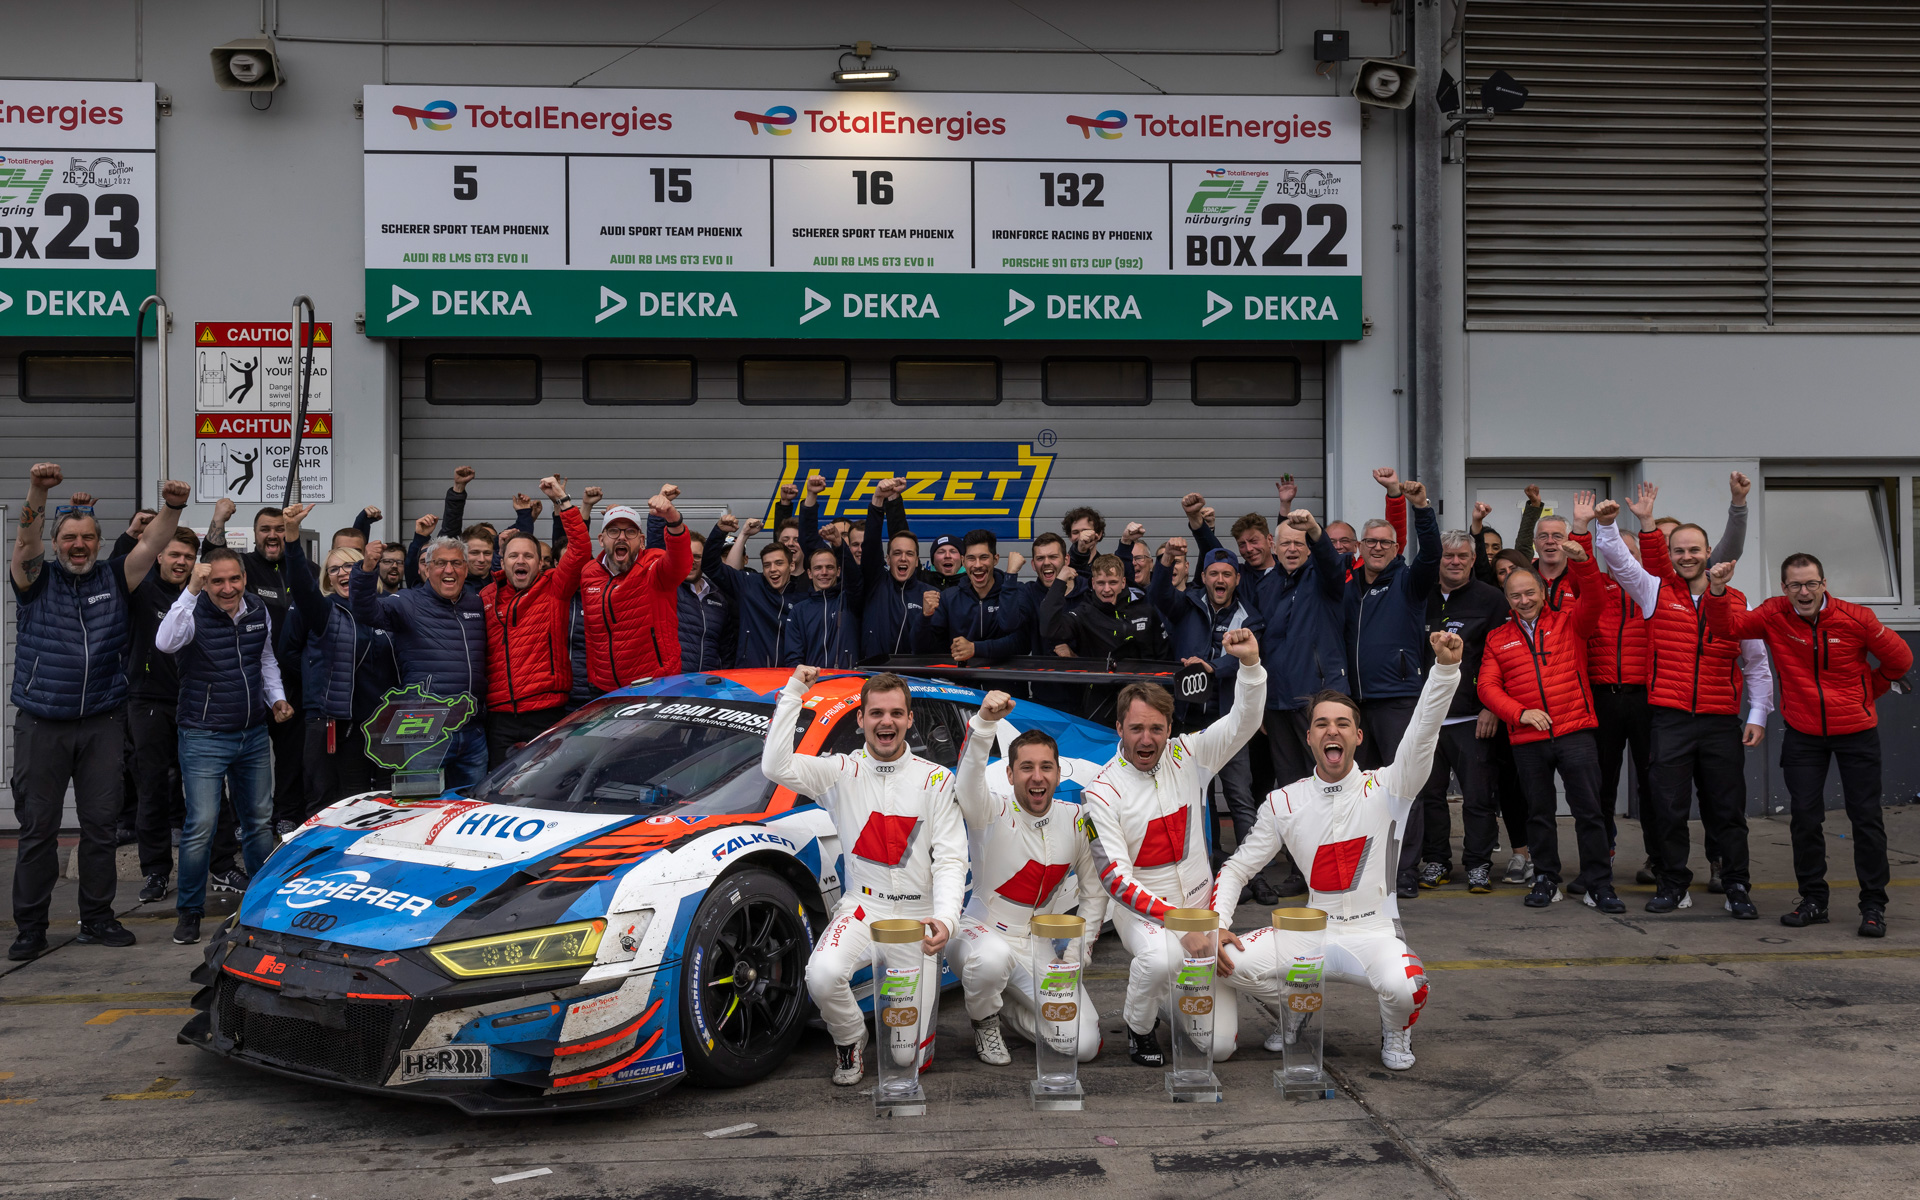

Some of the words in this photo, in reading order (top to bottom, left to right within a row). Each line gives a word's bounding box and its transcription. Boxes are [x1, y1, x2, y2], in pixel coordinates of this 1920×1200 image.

[0, 99, 123, 131] nergies
[464, 104, 673, 137] TotalEnergies
[804, 110, 1006, 141] TotalEnergies
[1134, 113, 1332, 144] TotalEnergies
[8, 158, 54, 166] TotalEnergies
[63, 171, 95, 184] 26-29
[108, 167, 134, 175] EDITION
[1227, 170, 1269, 178] TotalEnergies
[454, 165, 478, 200] 5
[649, 167, 693, 203] 15
[852, 170, 894, 205] 16
[1277, 182, 1306, 194] 26-29
[1318, 178, 1342, 187] EDITION
[1040, 172, 1105, 207] 132
[44, 193, 140, 259] 23
[1185, 214, 1252, 226] nürburgring
[381, 223, 431, 236] SCHERER
[433, 223, 468, 236] SPORT
[470, 224, 500, 236] TEAM
[503, 224, 549, 236] PHOENIX
[600, 225, 626, 237] AUDI
[628, 225, 663, 237] SPORT
[666, 225, 694, 238] TEAM
[697, 226, 743, 238] PHOENIX
[792, 227, 839, 240] SCHERER
[842, 228, 876, 240] SPORT
[878, 228, 907, 240] TEAM
[909, 228, 954, 240] PHOENIX
[992, 229, 1050, 240] IRONFORCE
[1051, 229, 1090, 241] RACING
[1092, 230, 1106, 241] BY
[1109, 229, 1153, 241] PHOENIX
[1187, 235, 1257, 266] BOX
[1261, 203, 1348, 267] 22
[403, 252, 429, 264] AUDI
[432, 252, 447, 264] R8
[449, 252, 472, 264] LMS
[474, 252, 494, 264] GT3
[497, 252, 518, 264] EVO
[521, 253, 529, 264] II
[610, 253, 636, 265] AUDI
[638, 254, 653, 265] R8
[655, 254, 678, 265] LMS
[680, 254, 700, 265] GT3
[703, 254, 724, 265] EVO
[726, 254, 734, 265] II
[813, 256, 838, 267] AUDI
[841, 256, 855, 267] R8
[857, 256, 879, 267] LMS
[881, 256, 901, 268] GT3
[904, 256, 924, 268] EVO
[926, 256, 934, 268] II
[1002, 257, 1050, 269] PORSCHE
[1052, 257, 1068, 269] 911
[1070, 257, 1089, 269] GT3
[1090, 257, 1113, 269] CUP
[1115, 257, 1143, 270] (992)
[26, 290, 130, 316] DEKRA
[432, 290, 532, 316] DEKRA
[639, 291, 738, 317] DEKRA
[843, 293, 940, 319] DEKRA
[1046, 294, 1142, 320] DEKRA
[1244, 296, 1339, 321] DEKRA
[227, 328, 293, 341] CAUTIO
[266, 446, 329, 456] KOPSTOß
[272, 458, 321, 468] GEAHR
[659, 703, 710, 717] GRAN
[824, 702, 846, 719] FRIJNS
[692, 717, 727, 727] DRIVING
[456, 812, 546, 842] HYLO
[276, 878, 433, 917] SCHERER
[1360, 910, 1376, 918] LINDE
[267, 961, 287, 974] R8
[1176, 984, 1210, 992] nürburgring
[1285, 982, 1320, 990] nürburgring
[880, 995, 914, 1004] nürburgring
[1040, 990, 1074, 998] nürburgring
[580, 1002, 598, 1010] Audi
[598, 995, 618, 1005] Sport
[896, 1031, 906, 1042] 1.
[1055, 1026, 1065, 1036] 1.
[406, 1050, 454, 1074] H&R
[618, 1061, 675, 1079] MICHELIN
